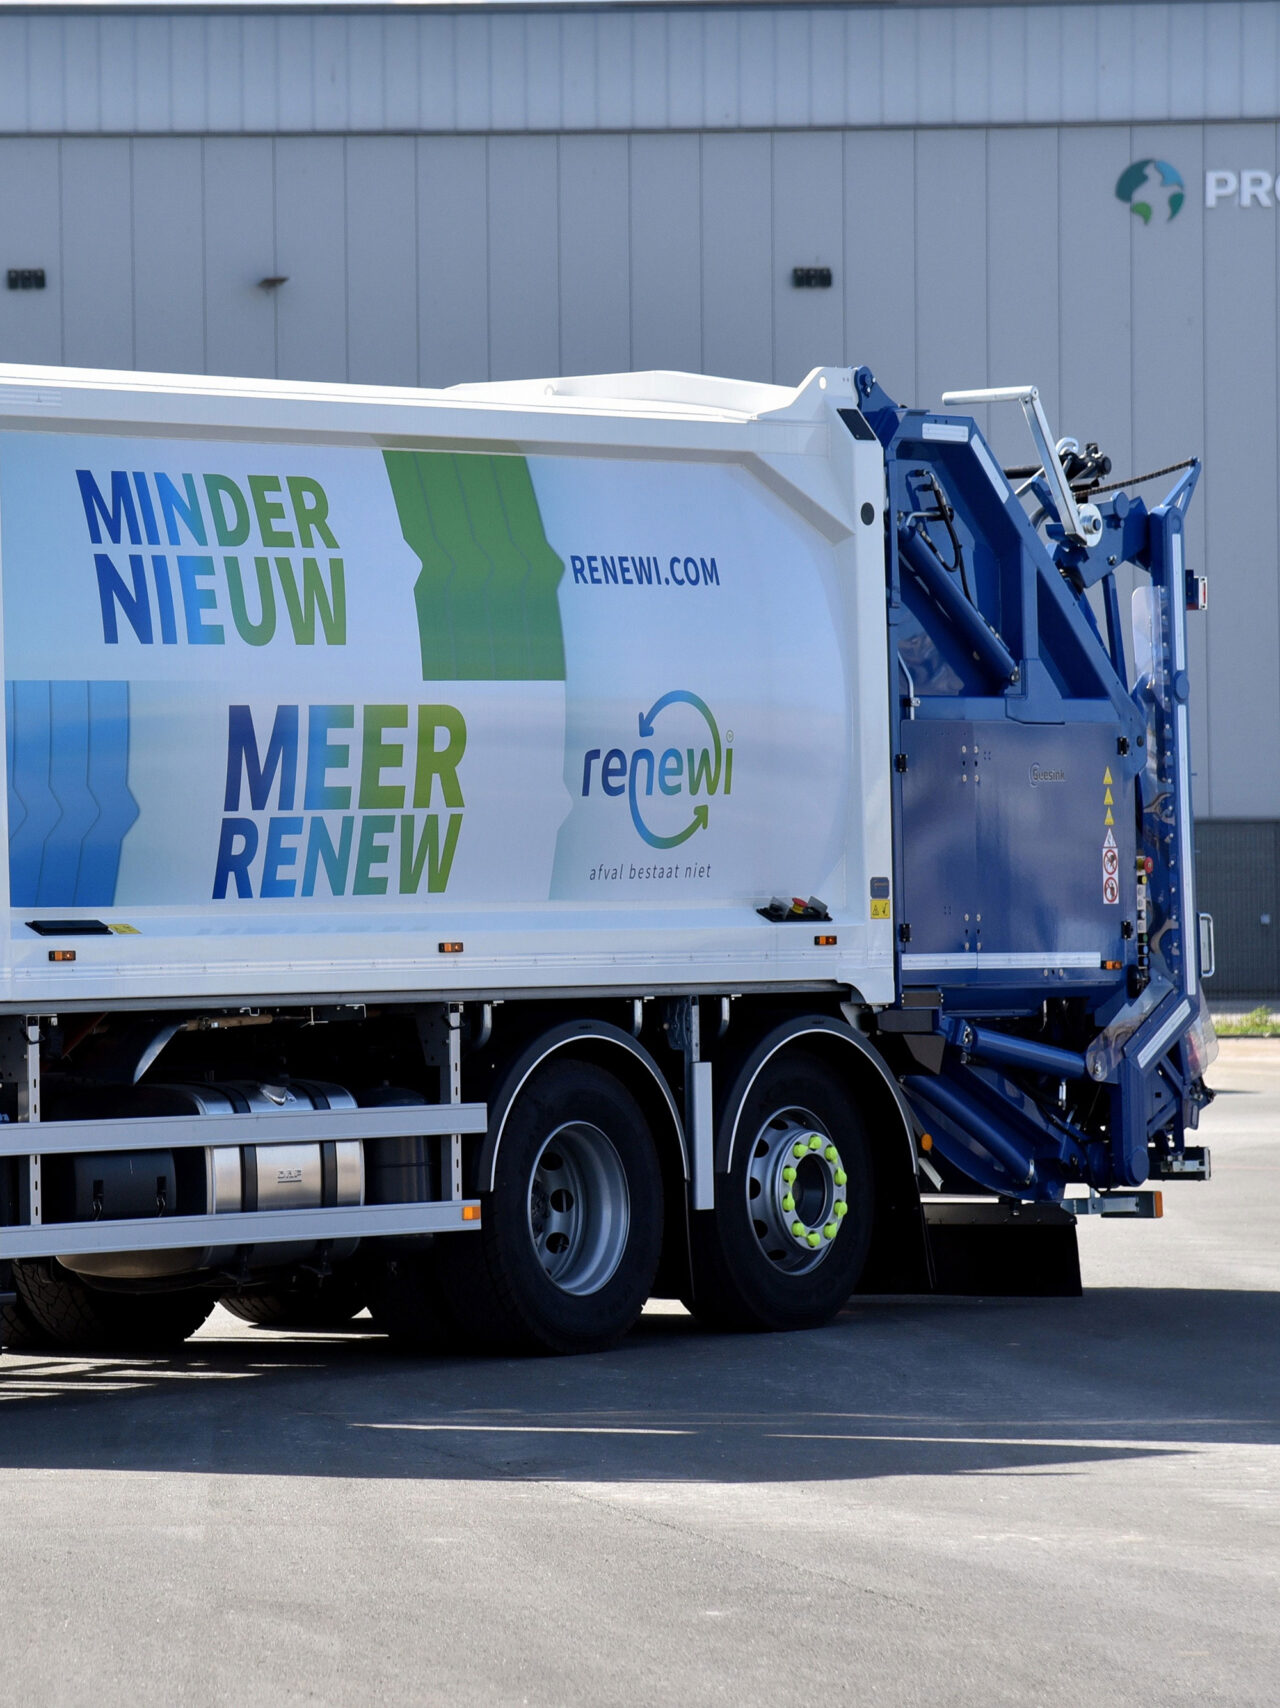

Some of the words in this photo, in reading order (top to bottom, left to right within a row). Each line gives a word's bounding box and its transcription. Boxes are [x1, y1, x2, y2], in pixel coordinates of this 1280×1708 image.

[1205, 170, 1280, 209] PR
[75, 469, 341, 549] MINDER
[93, 553, 347, 647] NIEUW
[570, 555, 720, 586] RENEWI.COM
[223, 704, 467, 812] MEER
[581, 747, 734, 797] renewi
[211, 813, 464, 900] RENEW
[589, 863, 624, 881] afval
[628, 863, 680, 880] bestaat
[684, 862, 712, 878] niet
